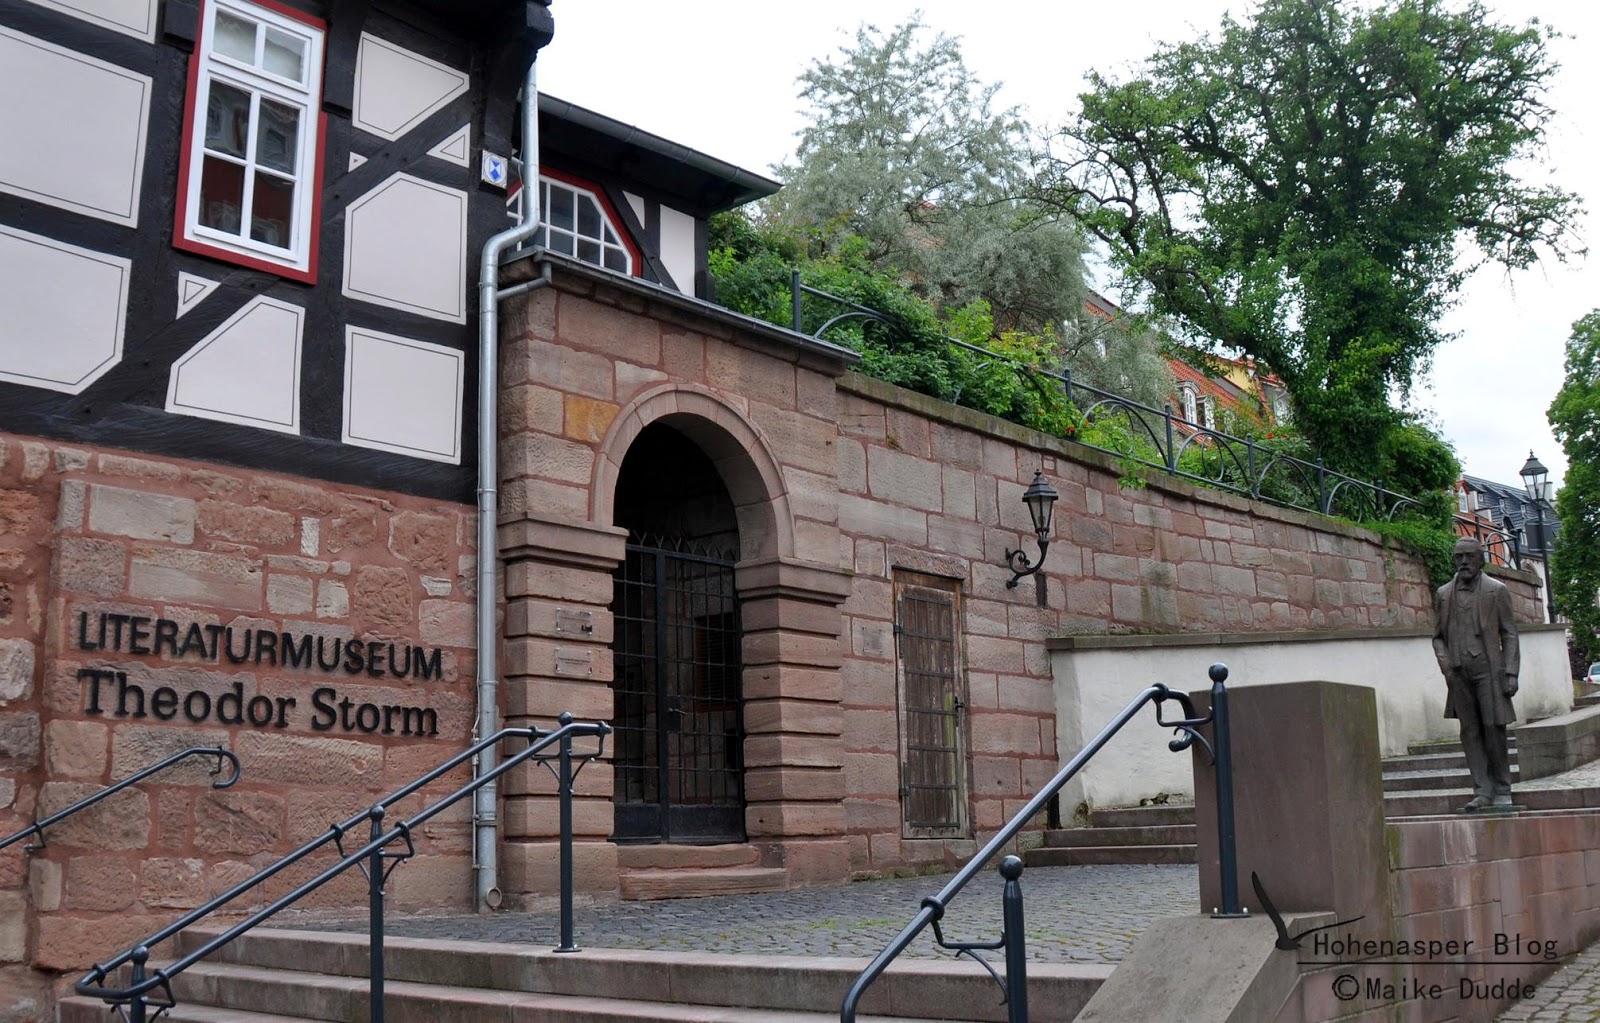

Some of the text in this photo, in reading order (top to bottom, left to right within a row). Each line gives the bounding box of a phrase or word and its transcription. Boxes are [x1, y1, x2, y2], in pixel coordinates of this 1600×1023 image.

[79, 611, 442, 680] LITERATURMUSEUM
[77, 668, 440, 736] Theodor Storm
